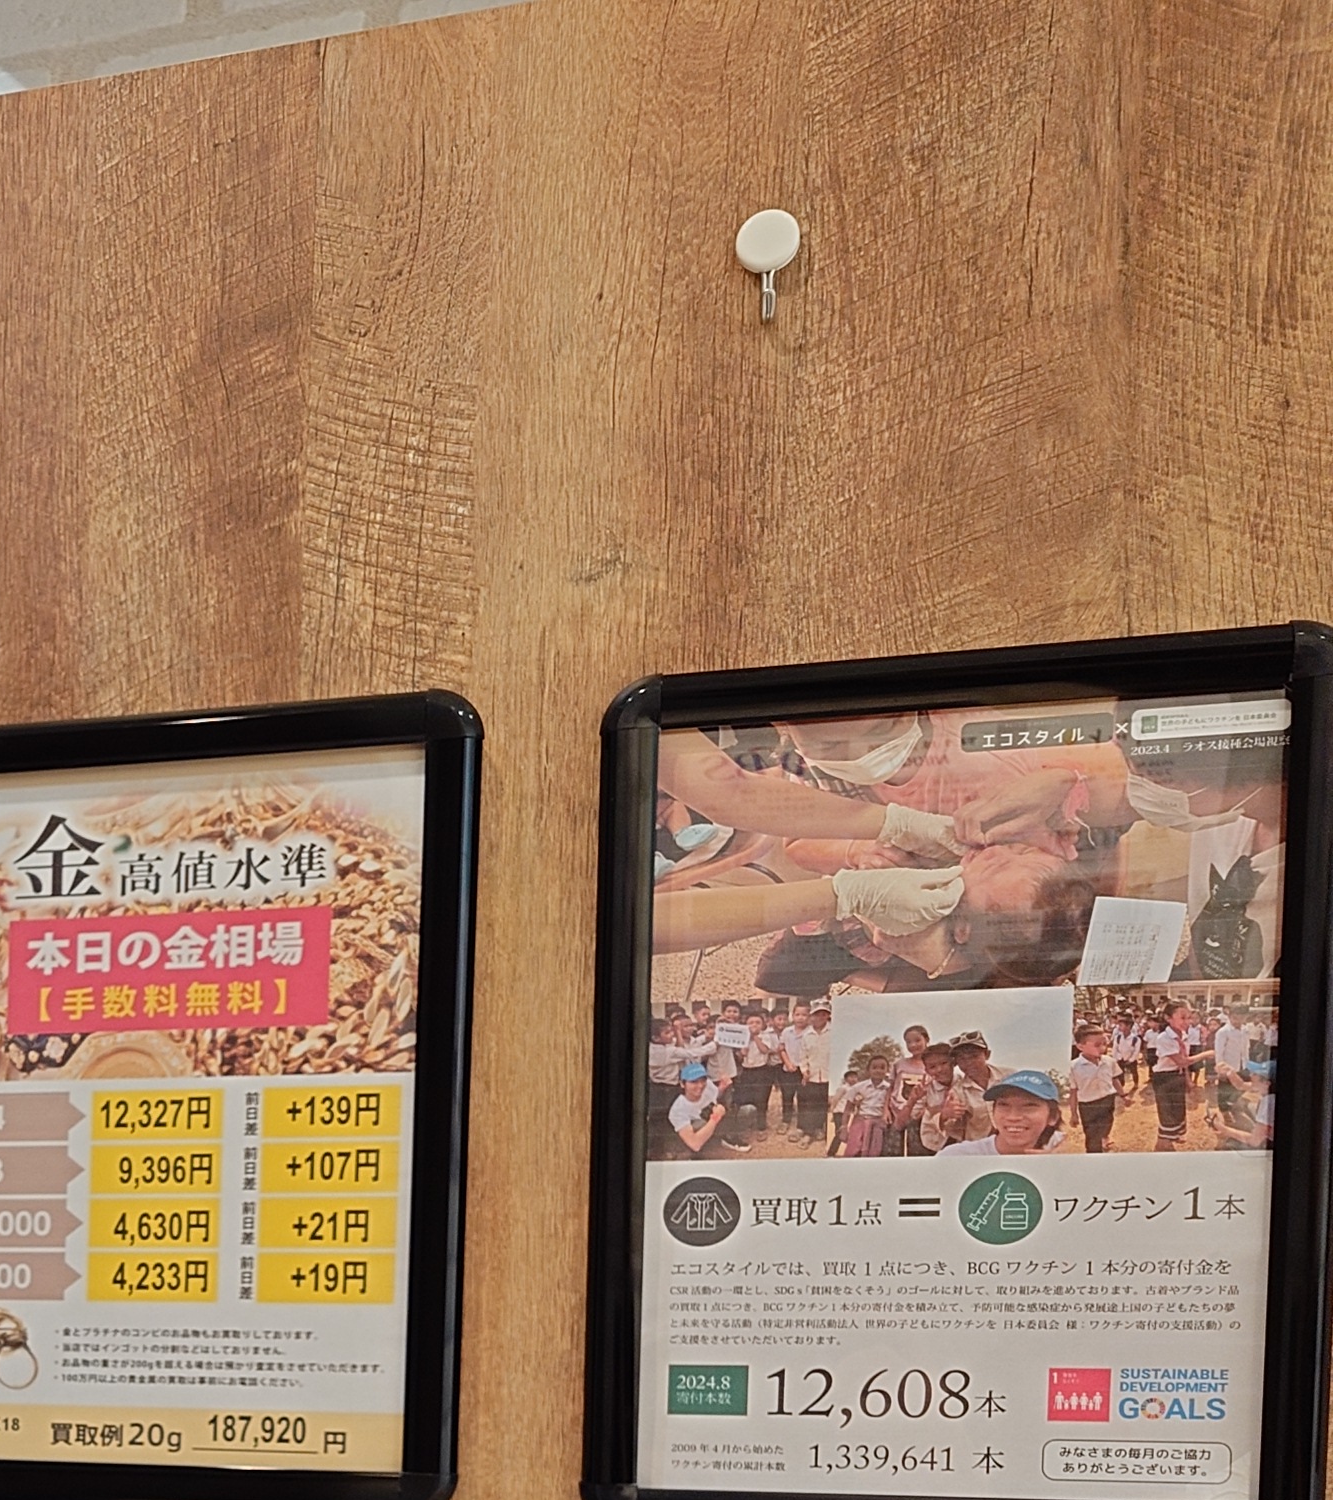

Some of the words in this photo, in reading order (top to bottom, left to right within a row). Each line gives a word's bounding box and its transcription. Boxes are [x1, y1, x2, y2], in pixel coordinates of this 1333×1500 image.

[981, 724, 1086, 749] エコスタイル
[14, 813, 106, 900] 金
[118, 843, 327, 898] 高値水準
[26, 922, 305, 976] 本日の金相場
[39, 978, 289, 1022] 【手数料無料】
[101, 1096, 211, 1133] 12,327円
[286, 1093, 381, 1127] +139円
[118, 1153, 214, 1189] 9,396円
[286, 1149, 380, 1182] +107円
[113, 1209, 211, 1246] 4,630円
[292, 1209, 369, 1243] +21円
[112, 1260, 209, 1296] 4,233円
[290, 1260, 368, 1294] +19円
[676, 1375, 730, 1390] 2024.8
[1119, 1382, 1229, 1393] DEVELOPMENT
[1120, 1369, 1229, 1380] SUSTAINABLE
[207, 1414, 307, 1450] 187,920
[1059, 1446, 1211, 1461] みなさまの毎月のご協力
[1062, 1462, 1207, 1476] ありがとうございます。
